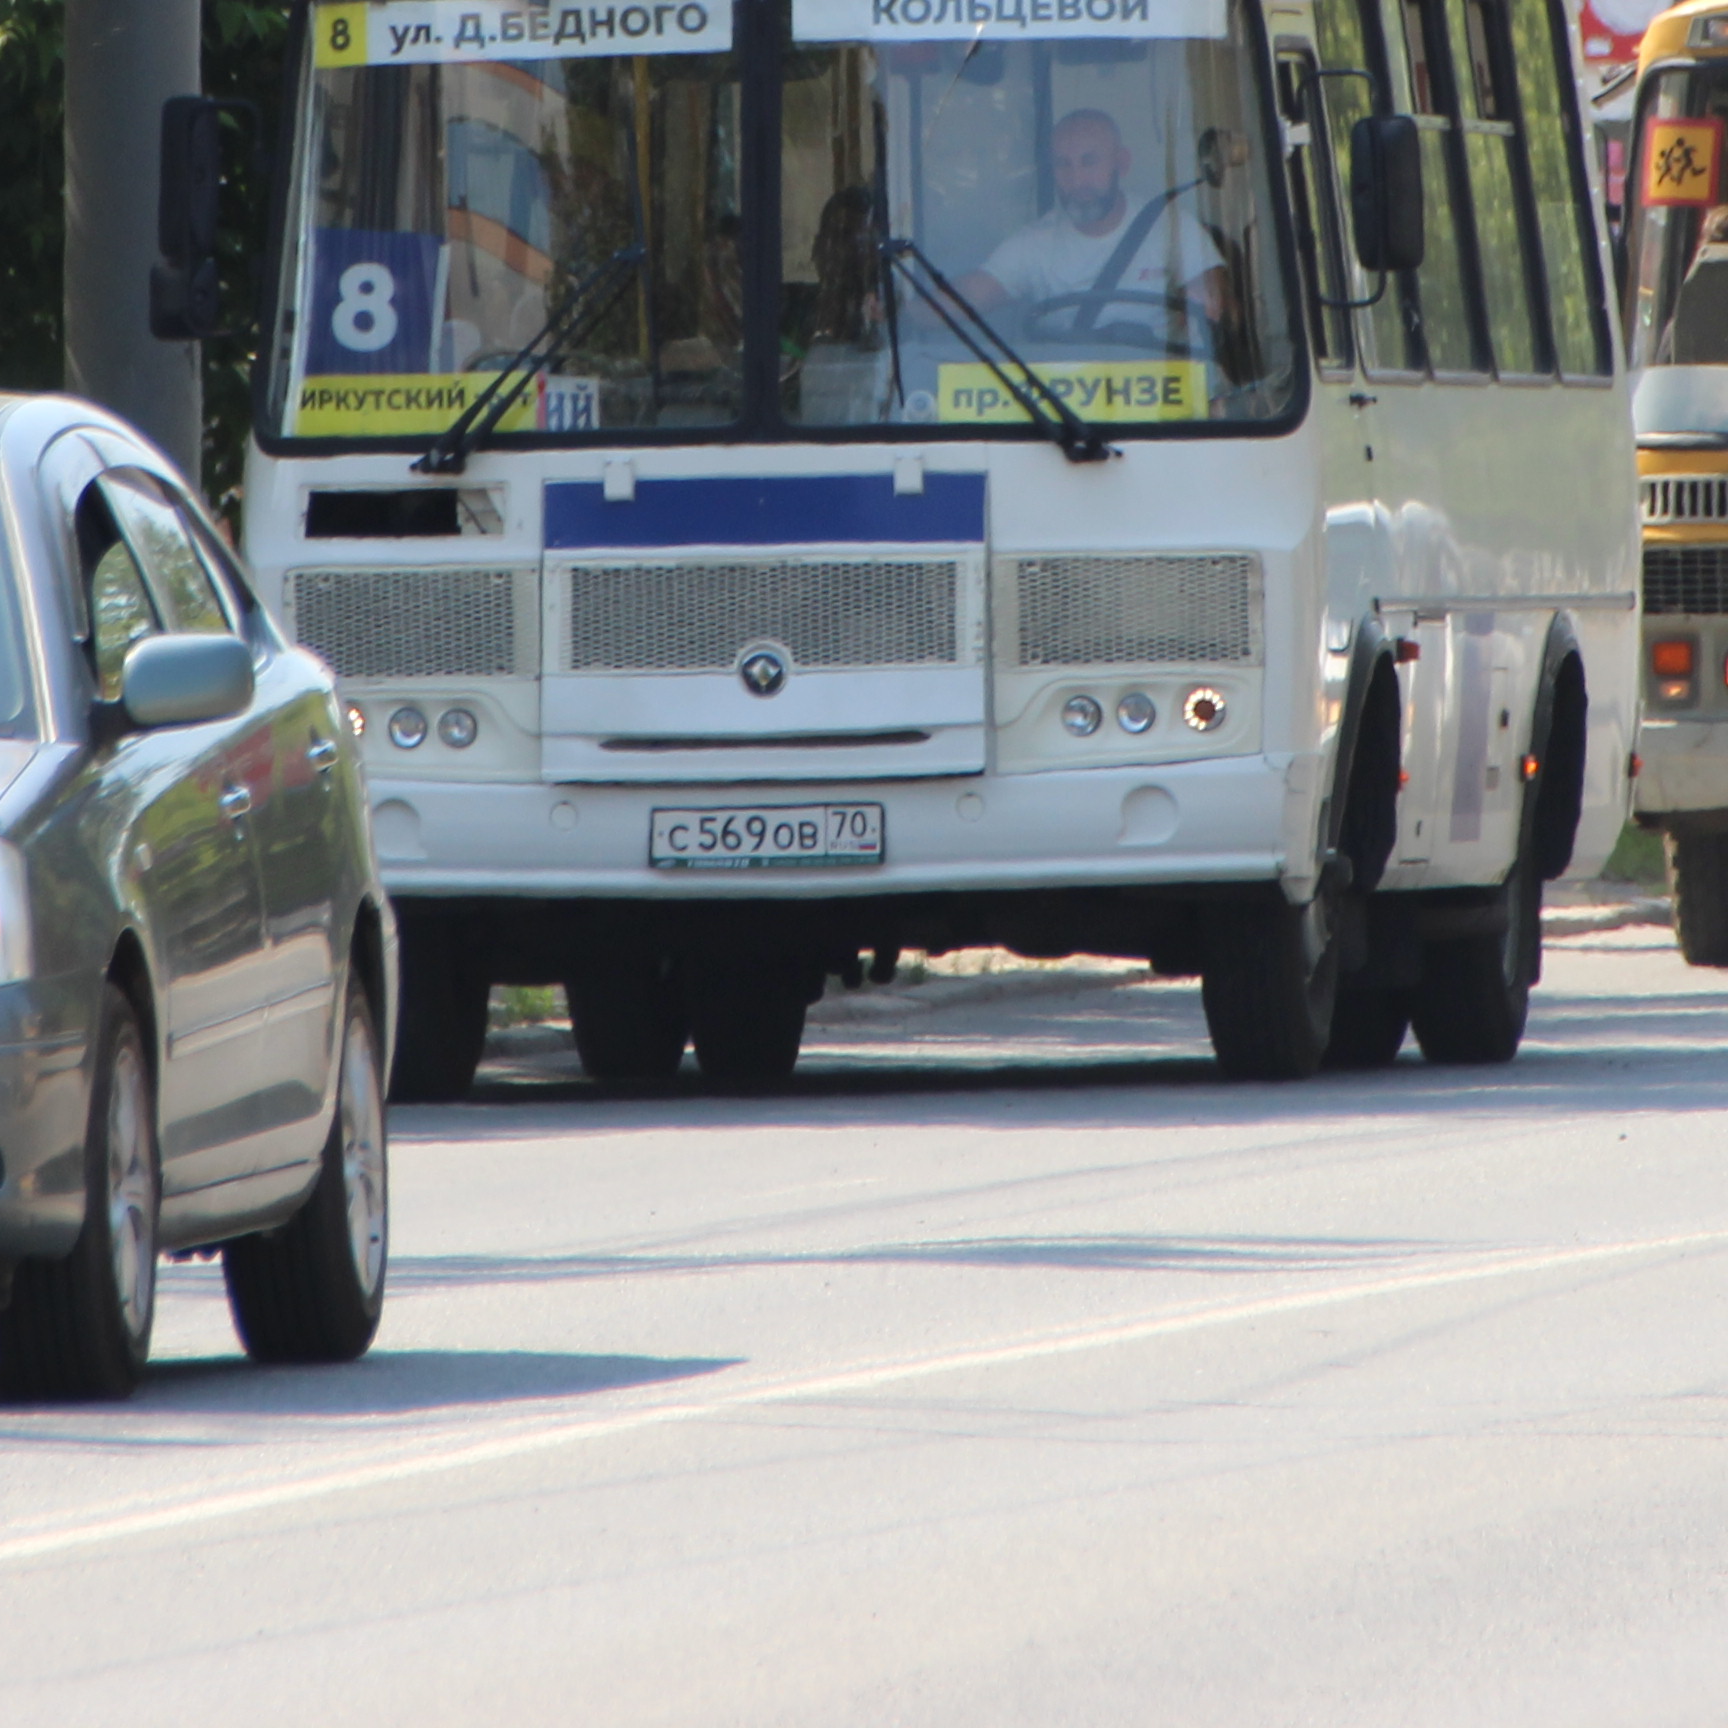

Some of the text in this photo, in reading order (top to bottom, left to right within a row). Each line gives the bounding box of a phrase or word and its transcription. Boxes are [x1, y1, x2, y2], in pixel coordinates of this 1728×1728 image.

[329, 2, 709, 55] 8 ул. Д.БЕДНОГО
[331, 262, 399, 353] 8
[300, 379, 466, 415] ИРКУТСКИЙ
[831, 810, 868, 840] 70
